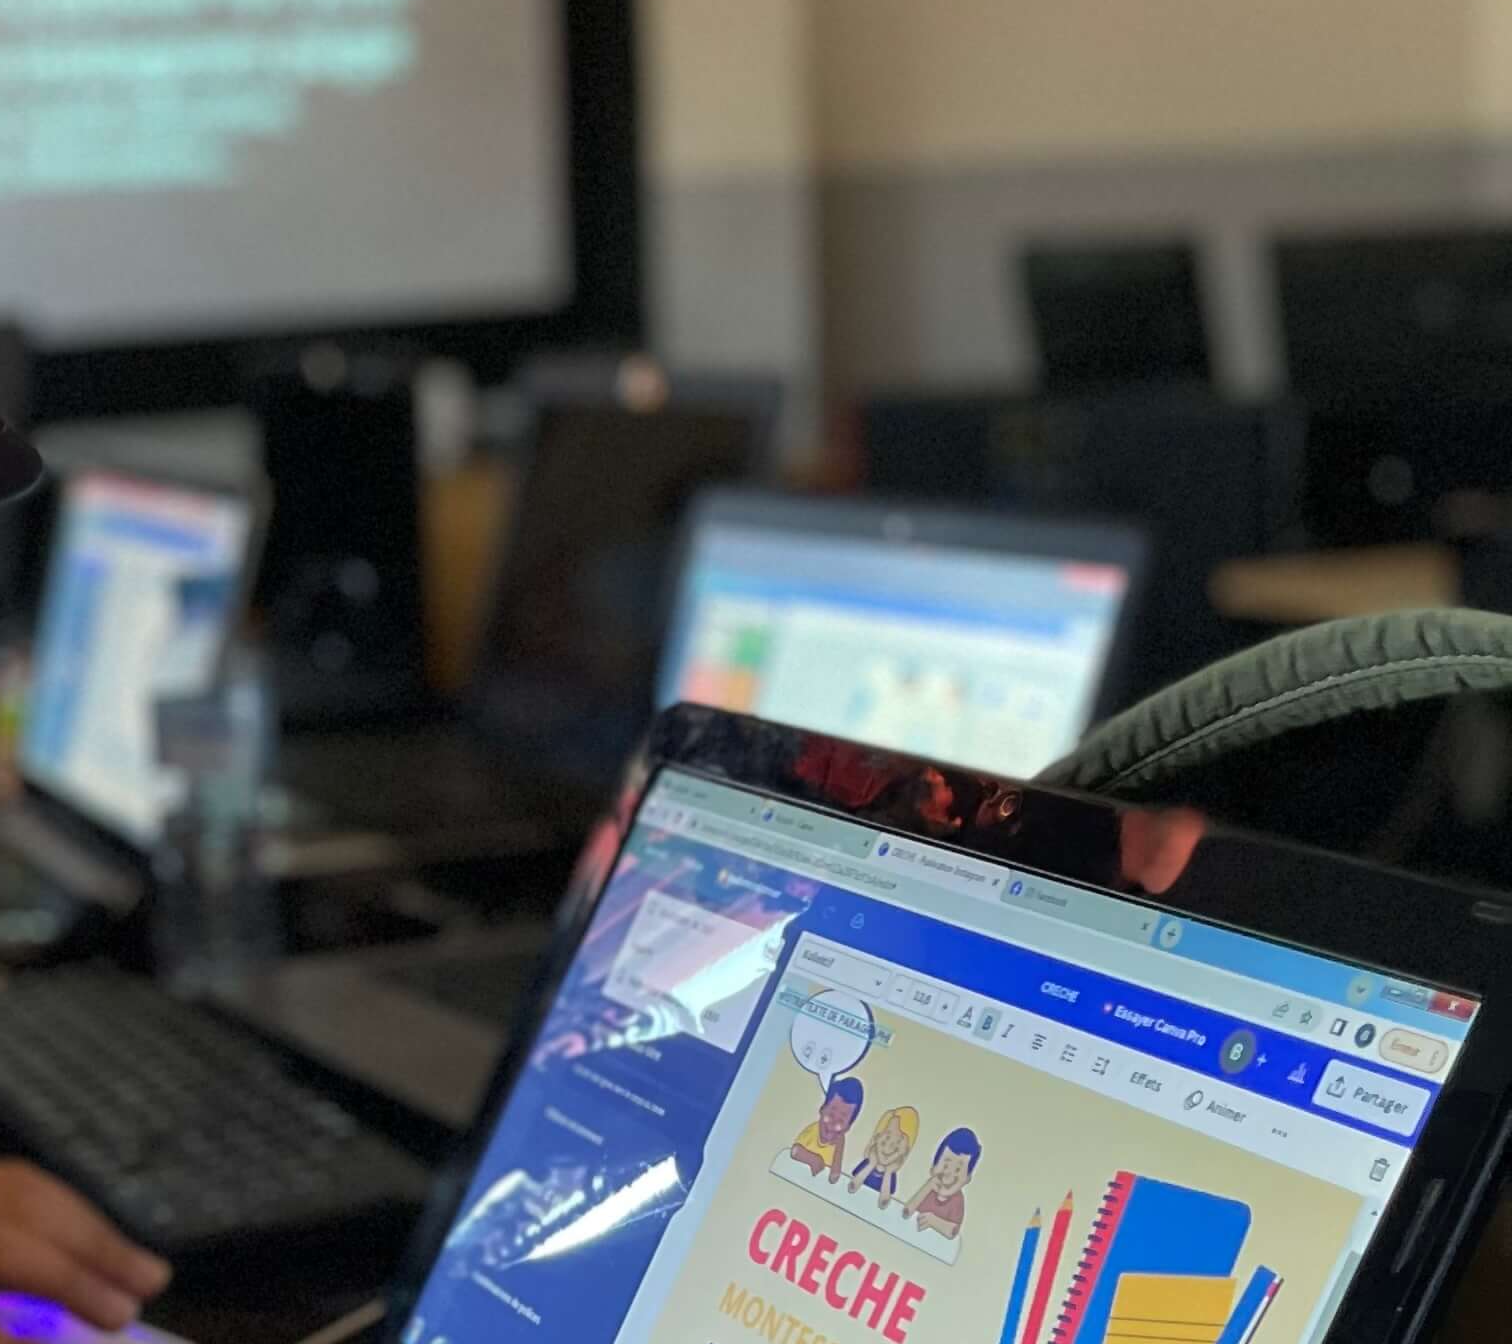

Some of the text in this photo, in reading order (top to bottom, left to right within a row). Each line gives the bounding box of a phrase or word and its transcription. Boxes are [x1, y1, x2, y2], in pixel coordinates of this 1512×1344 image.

[1113, 1005, 1208, 1047] Essayer Canva Pro
[1227, 1042, 1245, 1062] B
[1129, 1071, 1163, 1093] Effets
[1206, 1099, 1247, 1124] Animer
[1352, 1086, 1409, 1117] Partager
[749, 1209, 926, 1344] CRECHE
